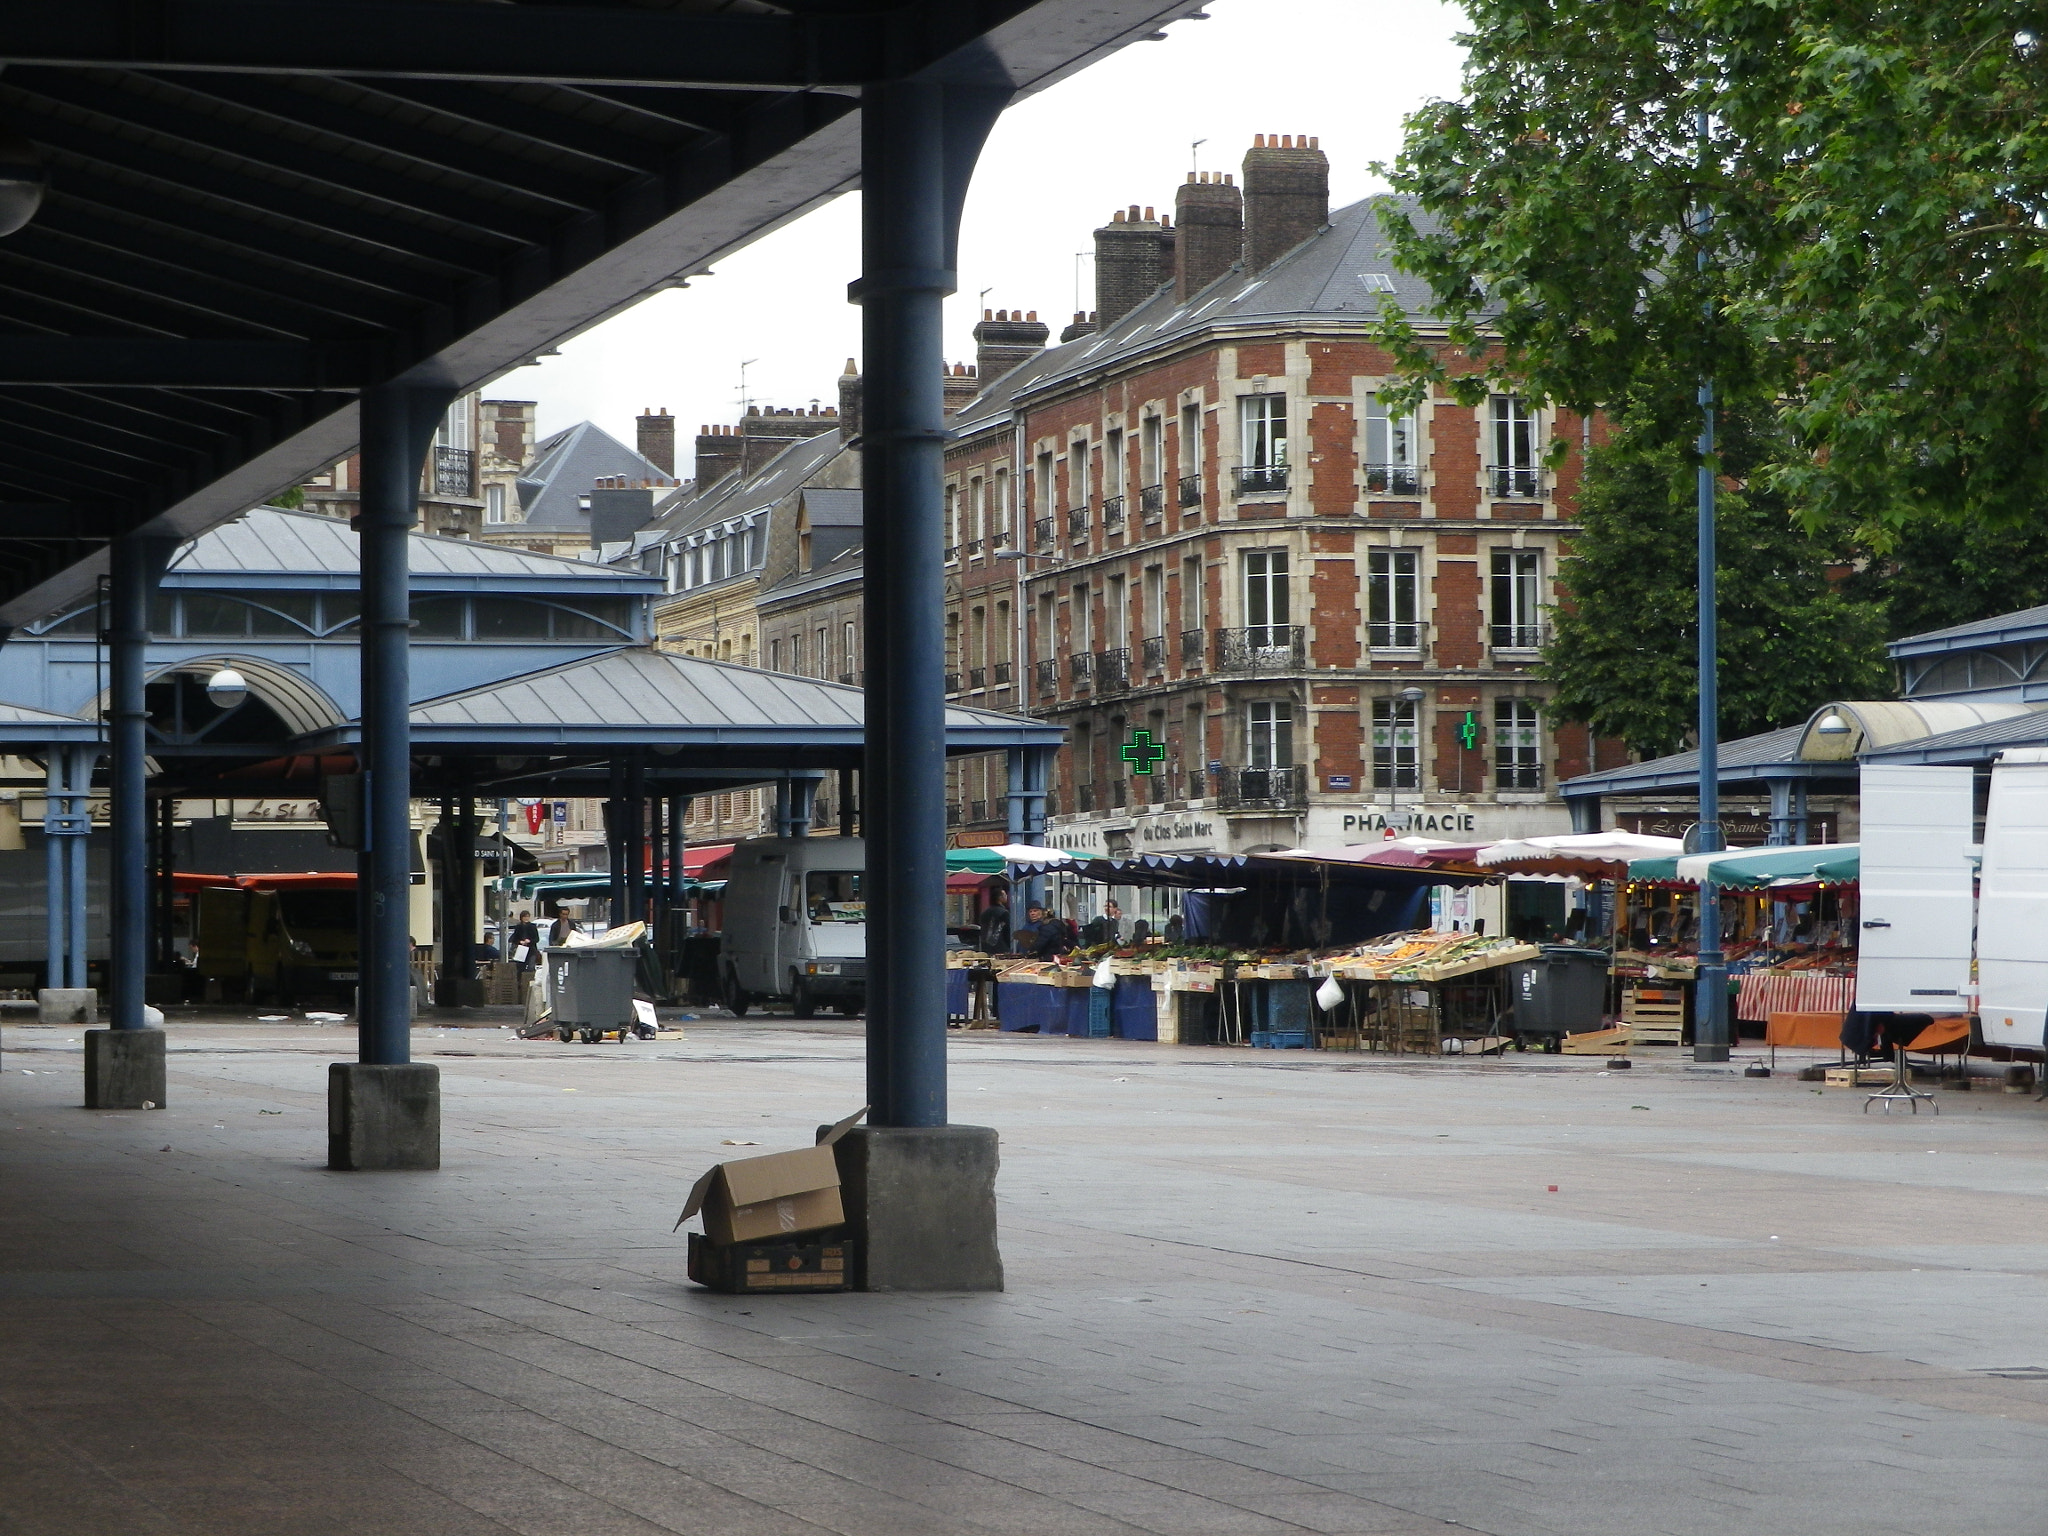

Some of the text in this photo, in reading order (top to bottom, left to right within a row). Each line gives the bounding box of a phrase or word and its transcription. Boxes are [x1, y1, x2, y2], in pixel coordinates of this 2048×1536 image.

[248, 799, 270, 817] Le
[1144, 820, 1212, 841] du Clos Saint Marc
[1343, 814, 1474, 831] PHAMACIE
[1045, 832, 1097, 849] HARMACIE
